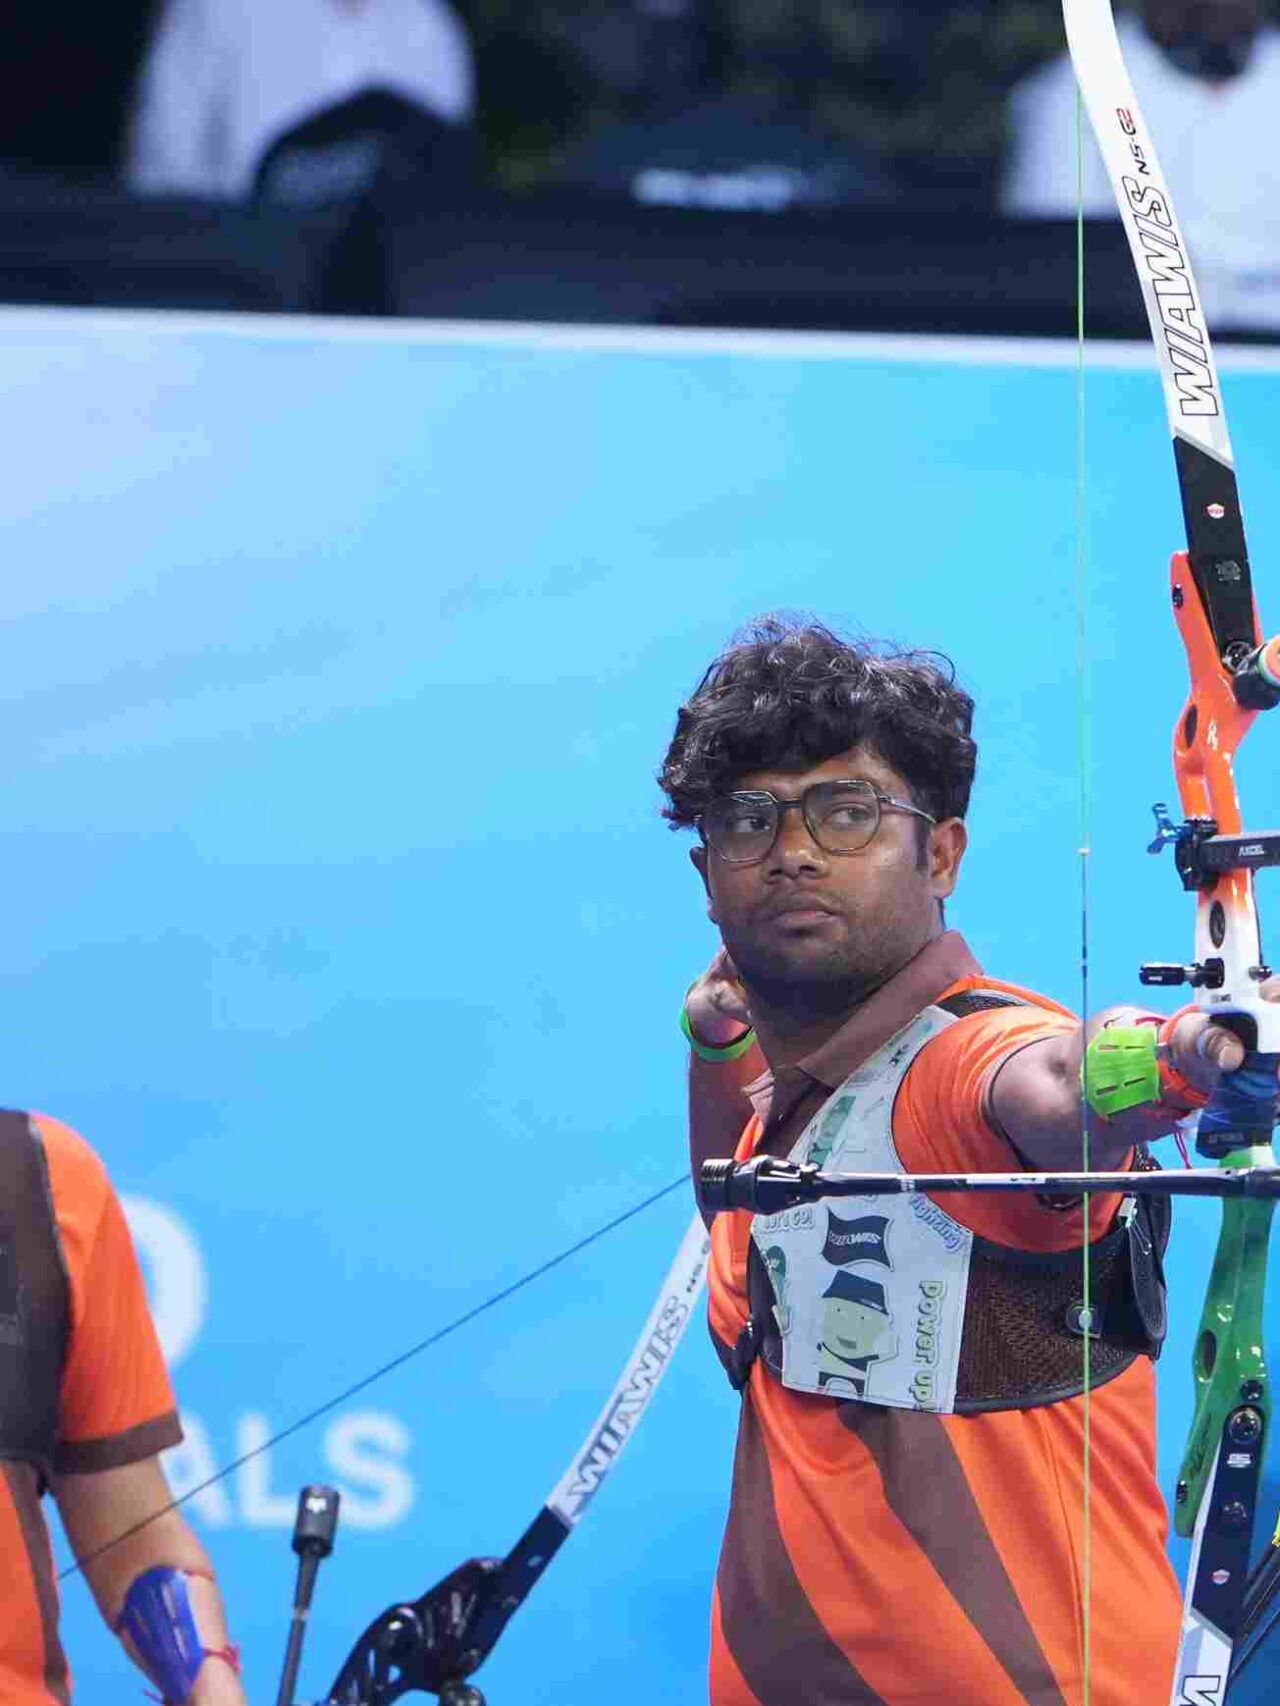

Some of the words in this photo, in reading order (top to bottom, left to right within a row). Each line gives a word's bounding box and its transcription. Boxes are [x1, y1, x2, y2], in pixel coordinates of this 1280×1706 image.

[1121, 176, 1219, 416] WIAWIS
[568, 1295, 689, 1513] WIAWIS
[916, 1280, 944, 1364] Power
